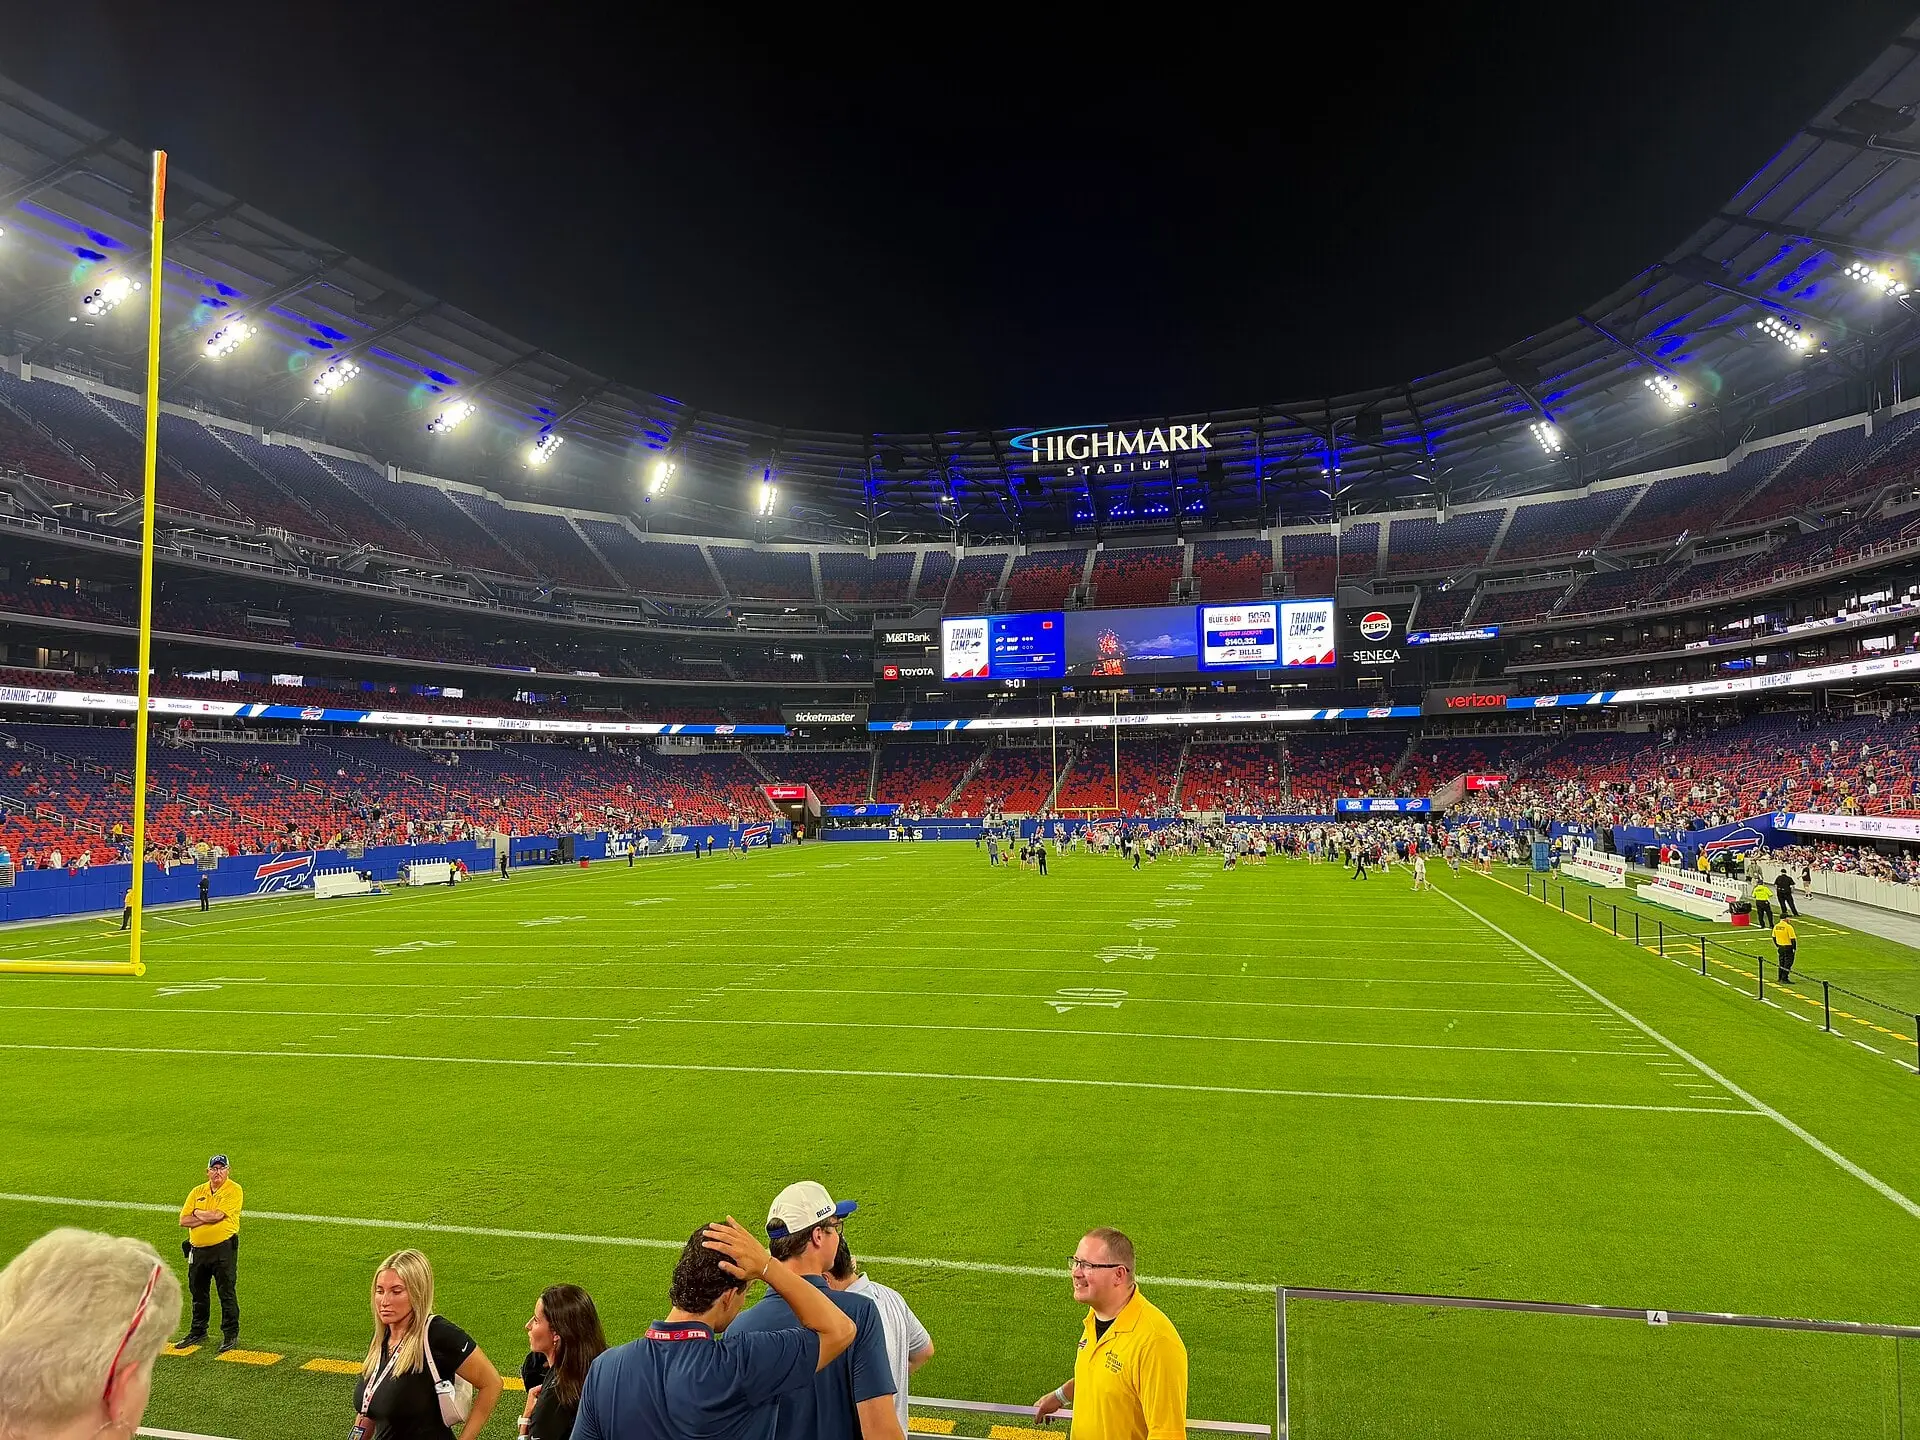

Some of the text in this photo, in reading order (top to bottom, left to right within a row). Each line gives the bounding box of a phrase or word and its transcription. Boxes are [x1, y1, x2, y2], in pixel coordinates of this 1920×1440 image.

[1032, 422, 1213, 463] HIGHMARK
[1066, 459, 1170, 477] STADIUM
[1291, 611, 1327, 625] TRAINING
[951, 627, 984, 640] TRAINING
[1289, 624, 1312, 637] CAMP
[885, 632, 931, 643] M&T Bank
[1225, 637, 1257, 646] $140,321
[950, 640, 970, 651] CAMP
[1239, 648, 1262, 656] BILLS
[1353, 649, 1401, 662] SENECA
[900, 667, 935, 677] TOYOTA
[1005, 678, 1026, 689] 9:01
[37, 691, 57, 703] CAMP
[1445, 692, 1507, 708] verizon
[795, 712, 856, 722] ticketmaster
[1043, 987, 1129, 1009] 10
[816, 1205, 832, 1218] BILLS
[1653, 1311, 1661, 1323] 4
